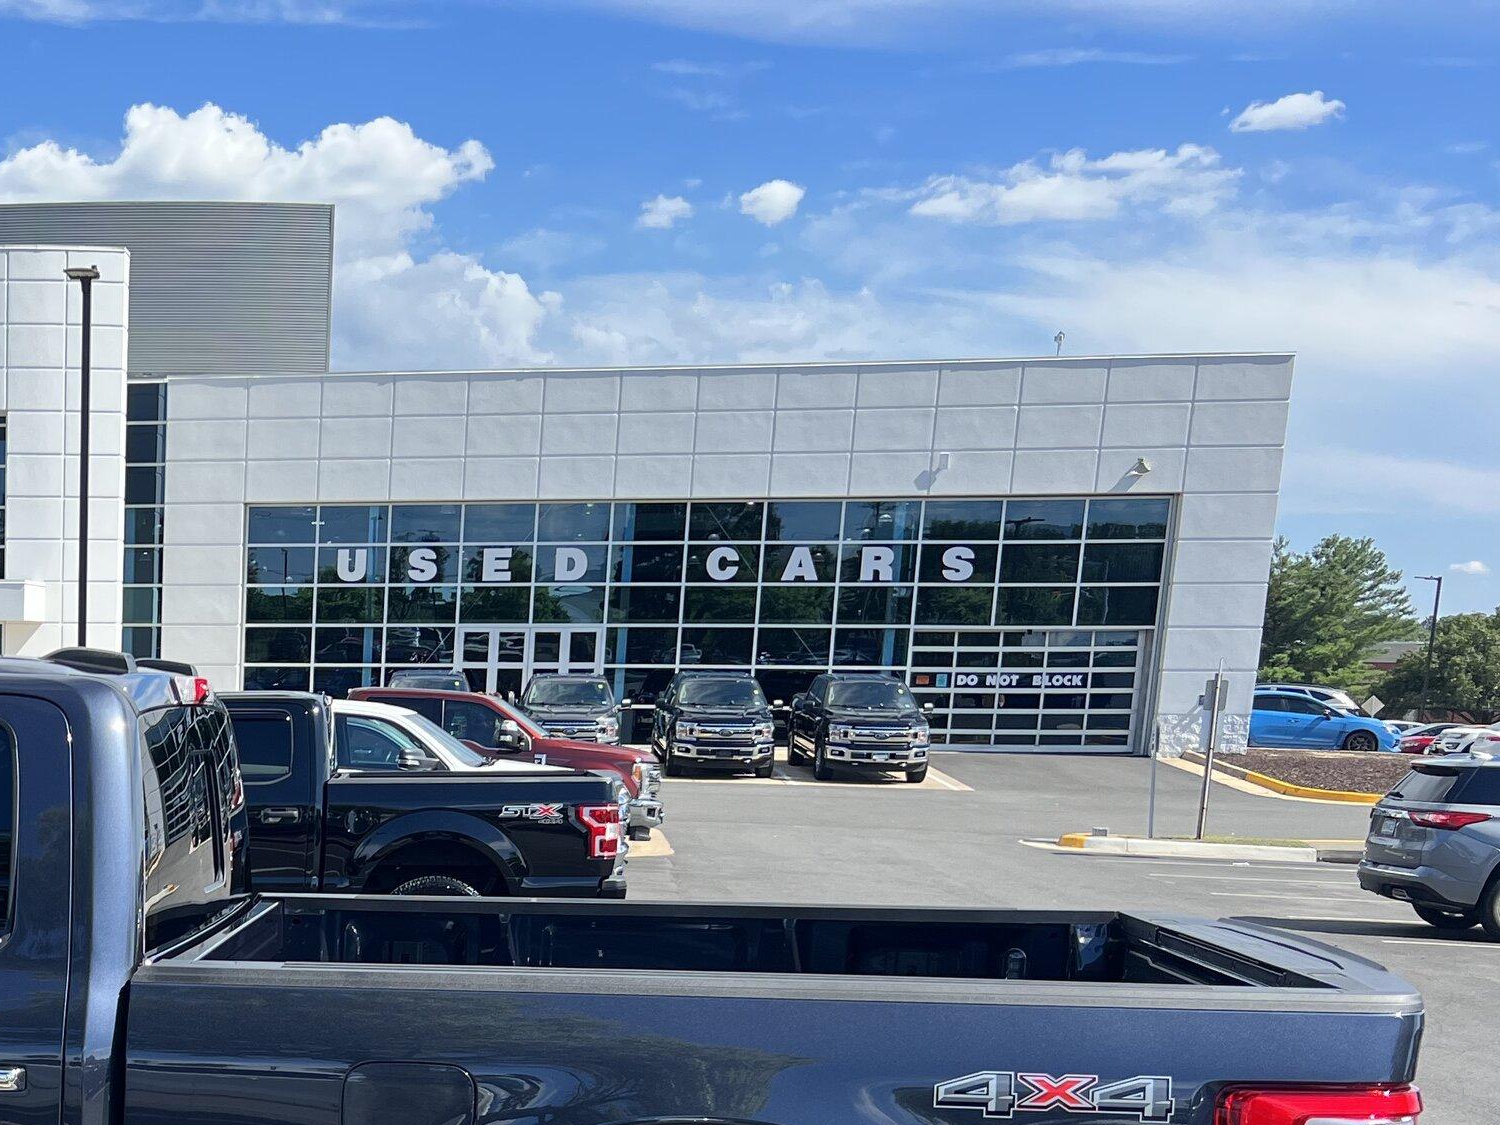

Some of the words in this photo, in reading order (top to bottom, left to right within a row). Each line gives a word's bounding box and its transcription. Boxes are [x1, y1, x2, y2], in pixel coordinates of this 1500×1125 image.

[337, 547, 588, 582] USED
[706, 546, 975, 581] CARS
[956, 674, 978, 686] DO
[985, 674, 1019, 686] NOT
[1032, 674, 1083, 686] BLOCK
[499, 803, 563, 819] STX
